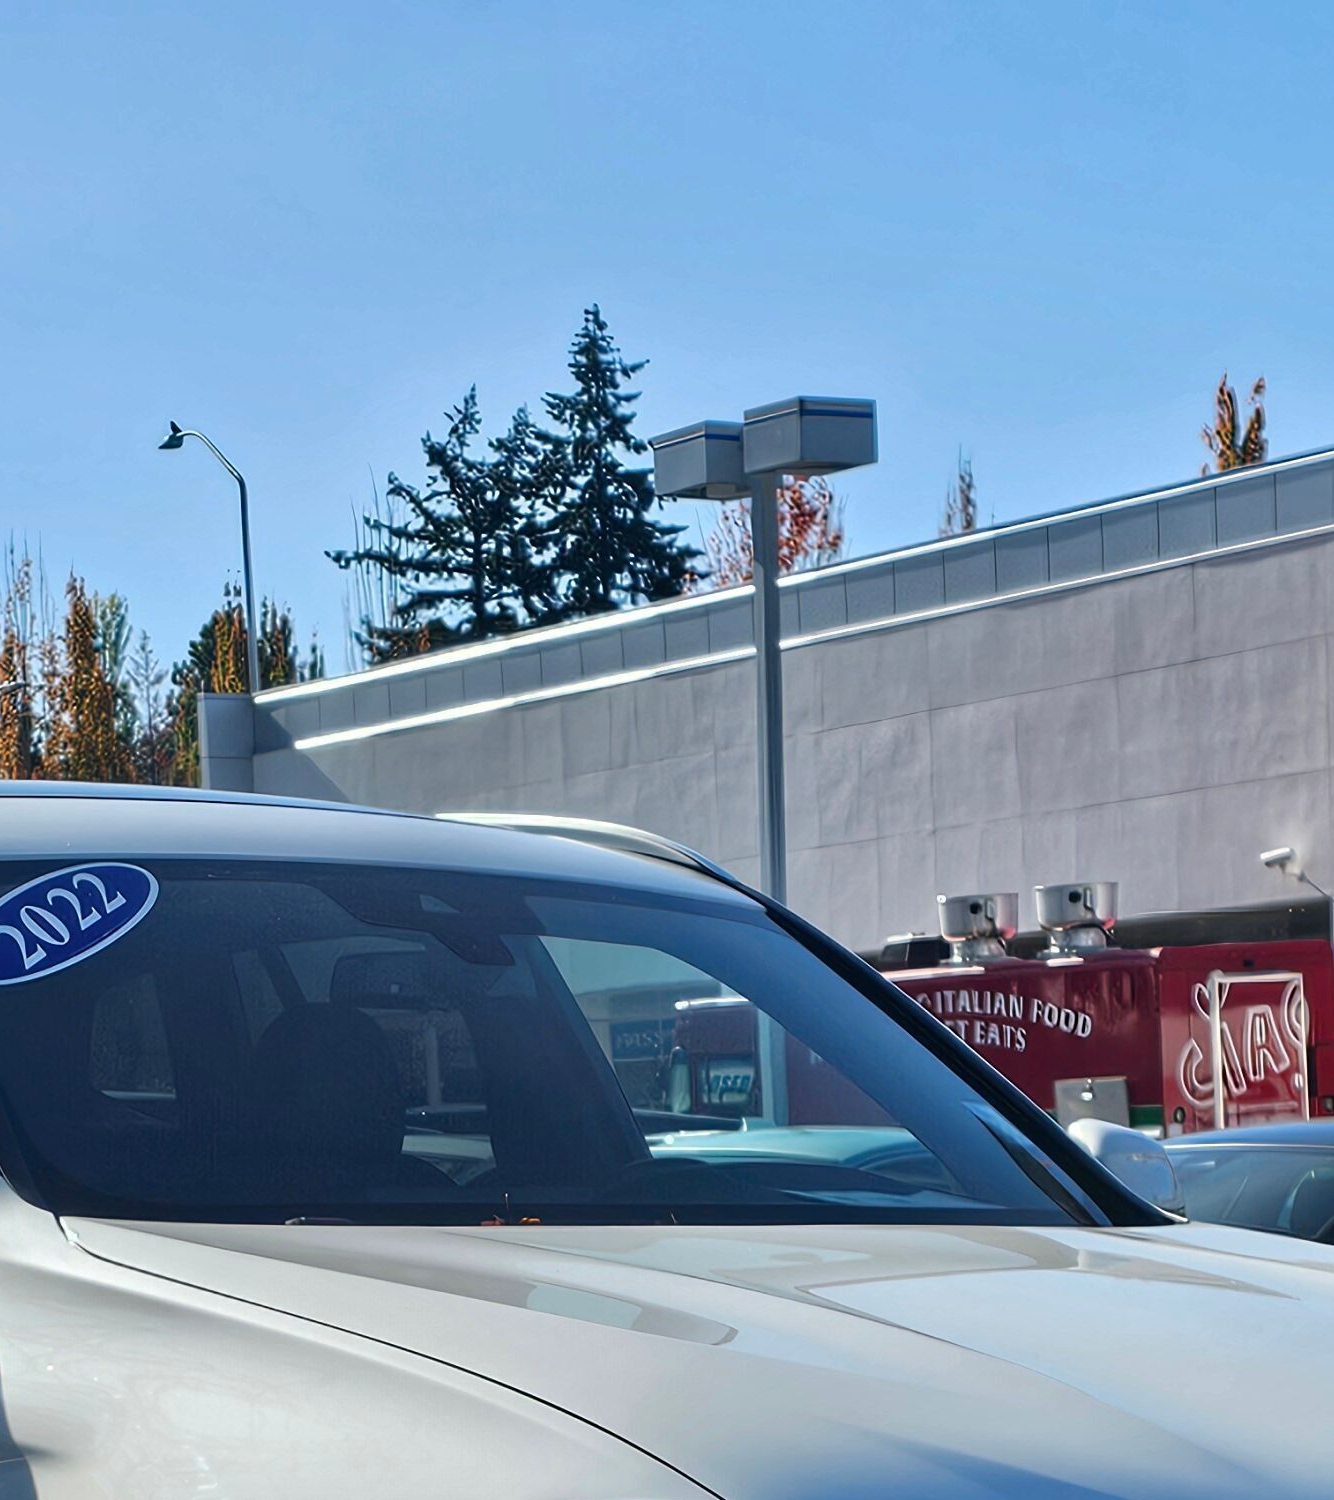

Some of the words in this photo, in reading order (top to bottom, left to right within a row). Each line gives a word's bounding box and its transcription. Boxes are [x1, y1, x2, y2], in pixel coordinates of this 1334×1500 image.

[935, 990, 1023, 1018] ITALIAN
[1031, 998, 1092, 1039] FOOD
[973, 1021, 1026, 1052] EATS
